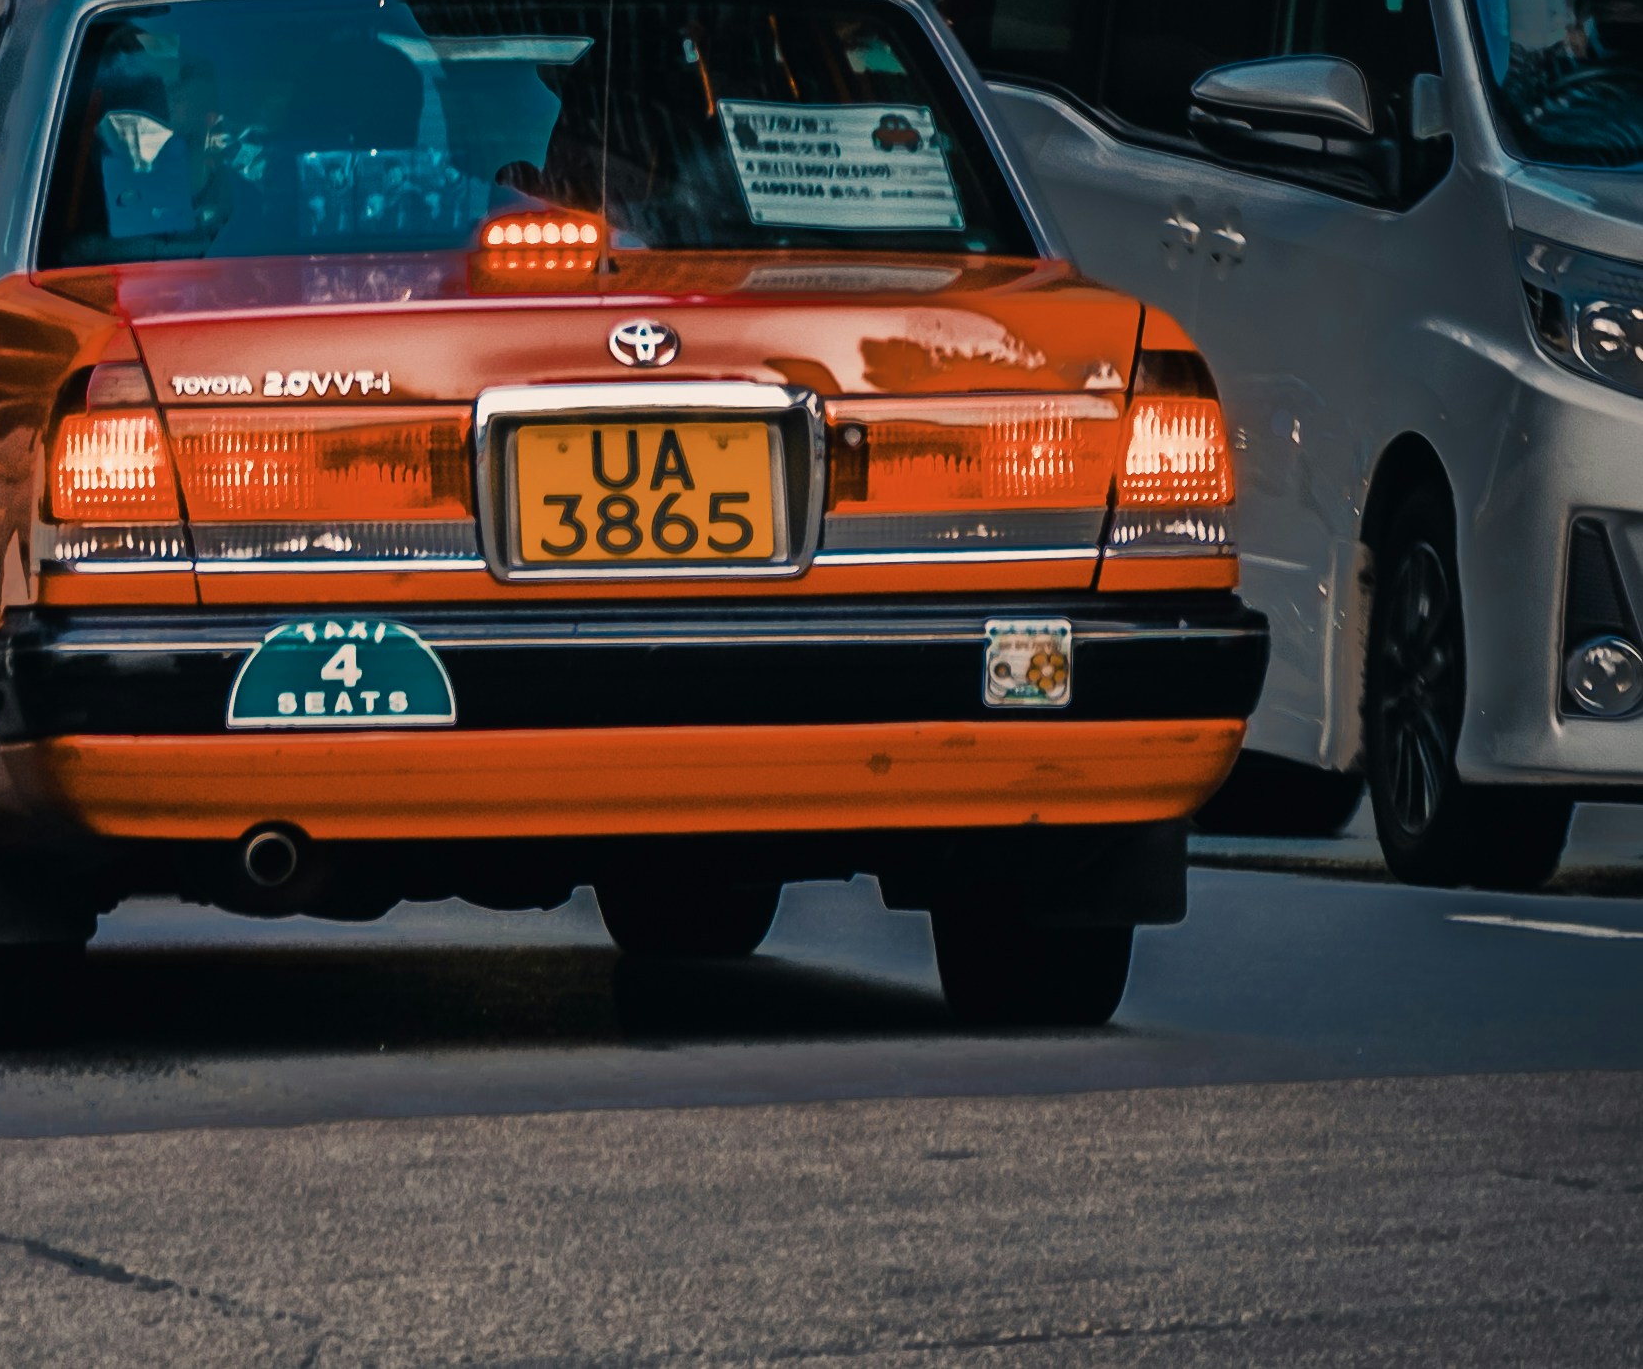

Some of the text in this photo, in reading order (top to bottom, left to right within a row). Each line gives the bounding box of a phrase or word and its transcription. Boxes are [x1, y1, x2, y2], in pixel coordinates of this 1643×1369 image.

[172, 374, 253, 397] TOYOTA
[590, 427, 695, 495] UA
[541, 491, 755, 559] 3865
[295, 619, 387, 644] TAXI
[320, 643, 363, 688] 4
[277, 690, 409, 716] SEATS
